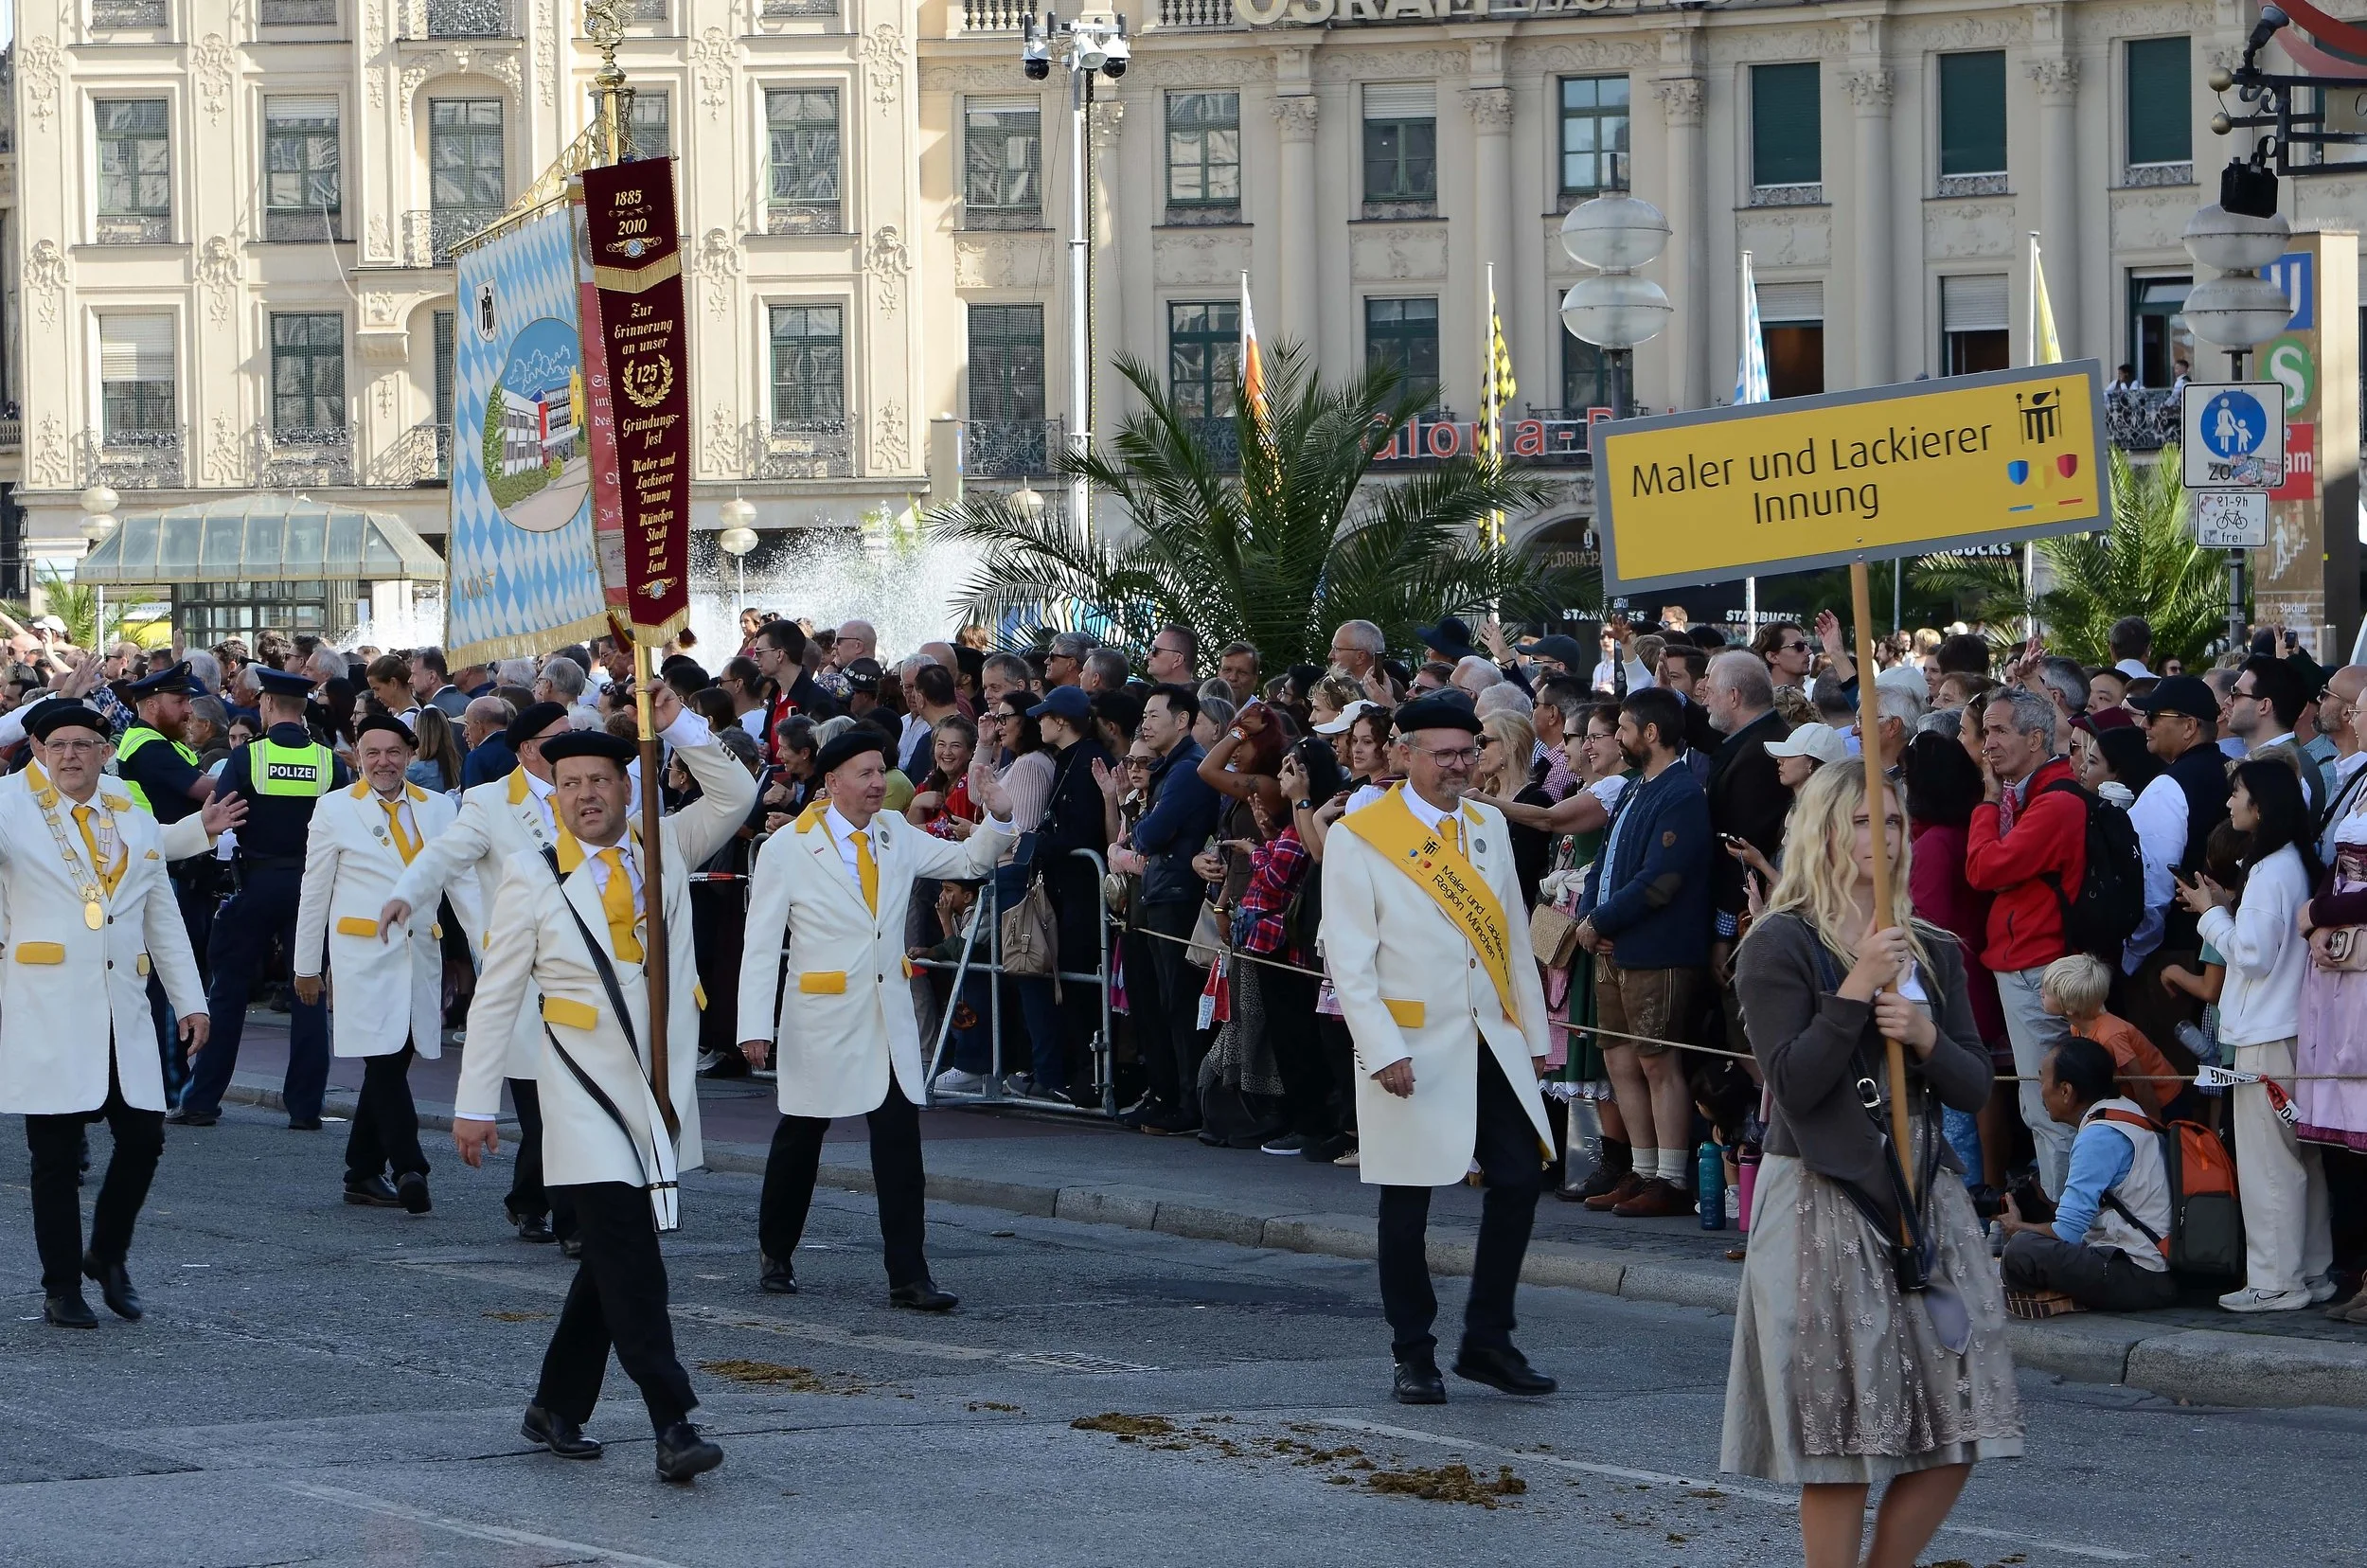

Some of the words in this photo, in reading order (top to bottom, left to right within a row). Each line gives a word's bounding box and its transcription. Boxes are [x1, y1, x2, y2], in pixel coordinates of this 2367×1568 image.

[615, 190, 642, 205] 1885
[618, 219, 648, 235] 2010
[632, 302, 653, 318] Zur
[614, 319, 673, 339] Erinnerung
[622, 344, 635, 355] an
[640, 336, 668, 352] unser
[636, 364, 658, 383] 125
[2269, 346, 2305, 409] S
[623, 414, 680, 437] Gründungs-
[644, 429, 662, 450] fest
[632, 457, 658, 473] Maler
[660, 452, 676, 468] und
[1633, 454, 1734, 497] Maler
[1750, 437, 1816, 481] und
[1831, 423, 1993, 472] Lackierer
[635, 472, 674, 490] Lackierer
[640, 490, 671, 505] Innung
[1754, 483, 1878, 525] Innung
[2217, 496, 2249, 508] 21-9h
[639, 508, 674, 527] München
[646, 526, 667, 543] Stadt
[2221, 532, 2243, 543] frei
[649, 542, 665, 557] und
[647, 557, 667, 575] Land
[2280, 601, 2308, 614] Stachus
[269, 765, 316, 779] POLIZEI
[1441, 864, 1468, 894] Maler
[1467, 894, 1486, 915] und
[1432, 874, 1465, 911] Region
[1466, 911, 1495, 960] München
